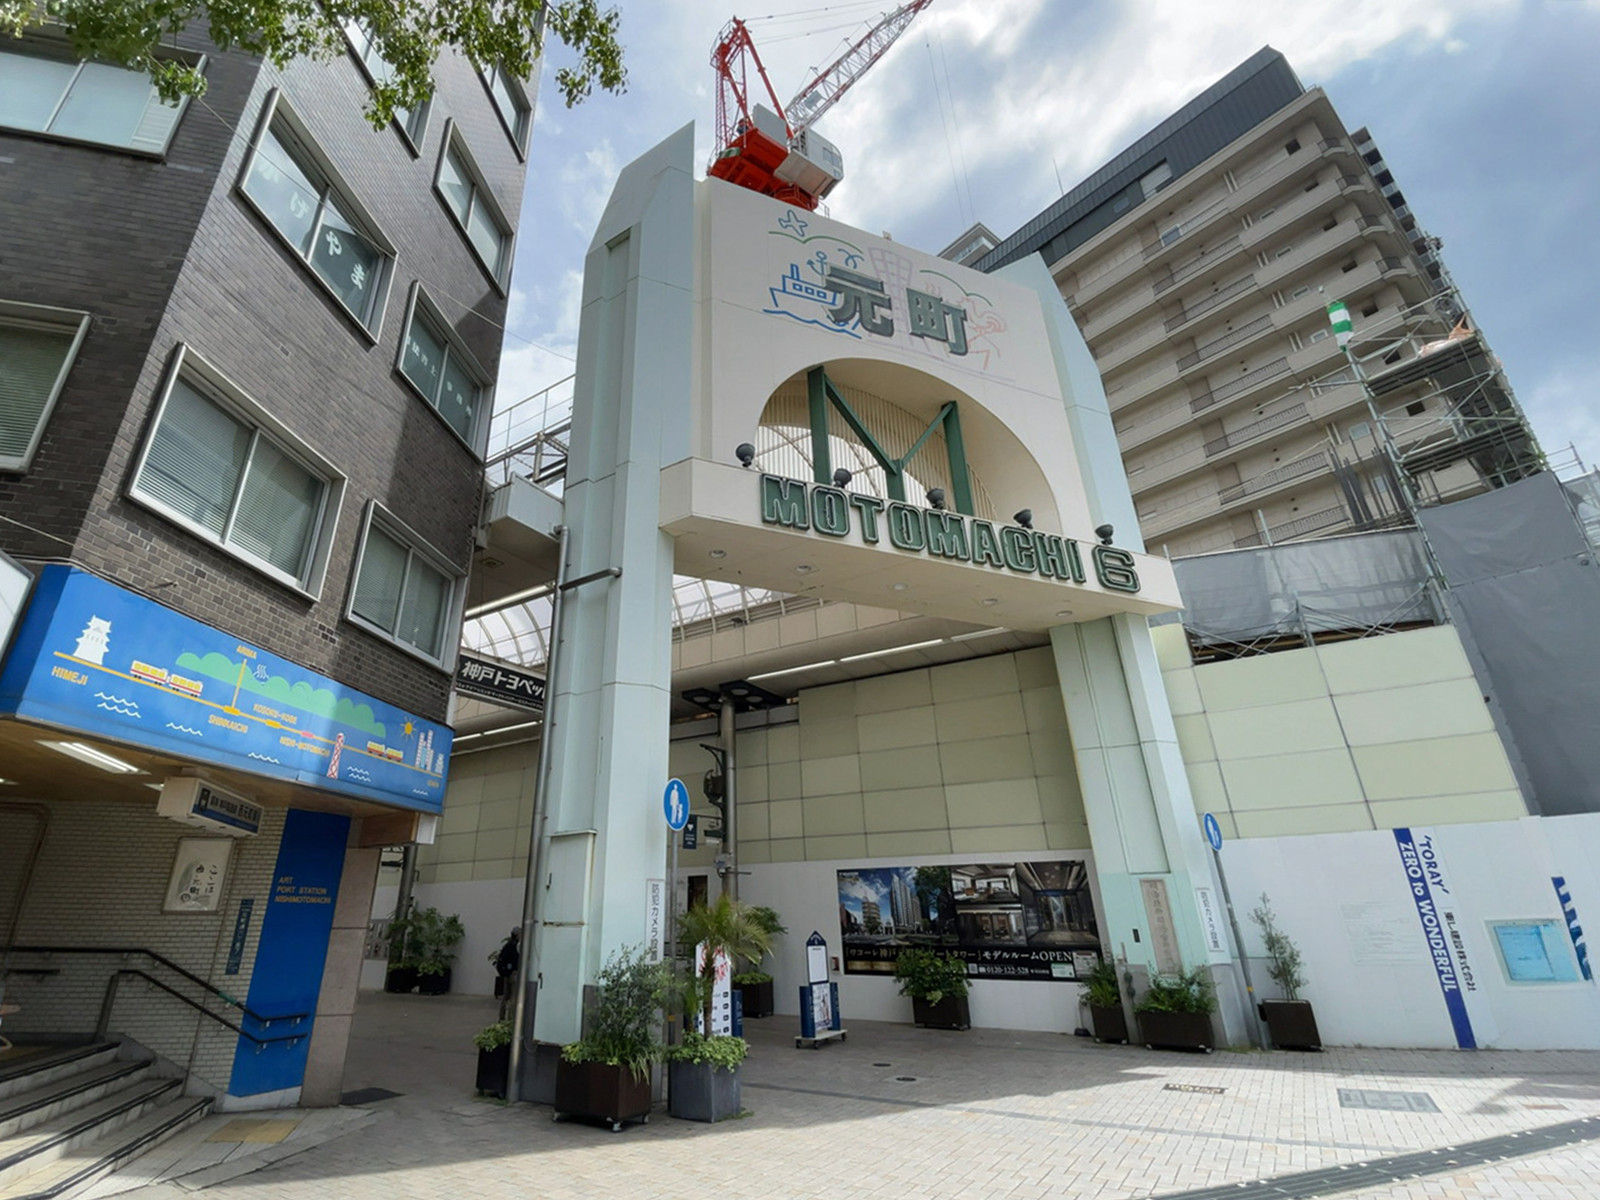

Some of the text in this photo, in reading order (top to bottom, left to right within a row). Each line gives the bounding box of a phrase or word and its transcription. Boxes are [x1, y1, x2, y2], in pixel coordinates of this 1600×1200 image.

[823, 263, 969, 357] 元町
[760, 473, 1140, 593] MOTOMACHI 6
[51, 665, 89, 686] HIMEJI
[276, 886, 328, 895] PORT STATION
[278, 876, 294, 884] ART
[274, 895, 332, 904] NISHIMOTOMACHI
[1399, 842, 1457, 992] ZERO to WONDERFUL
